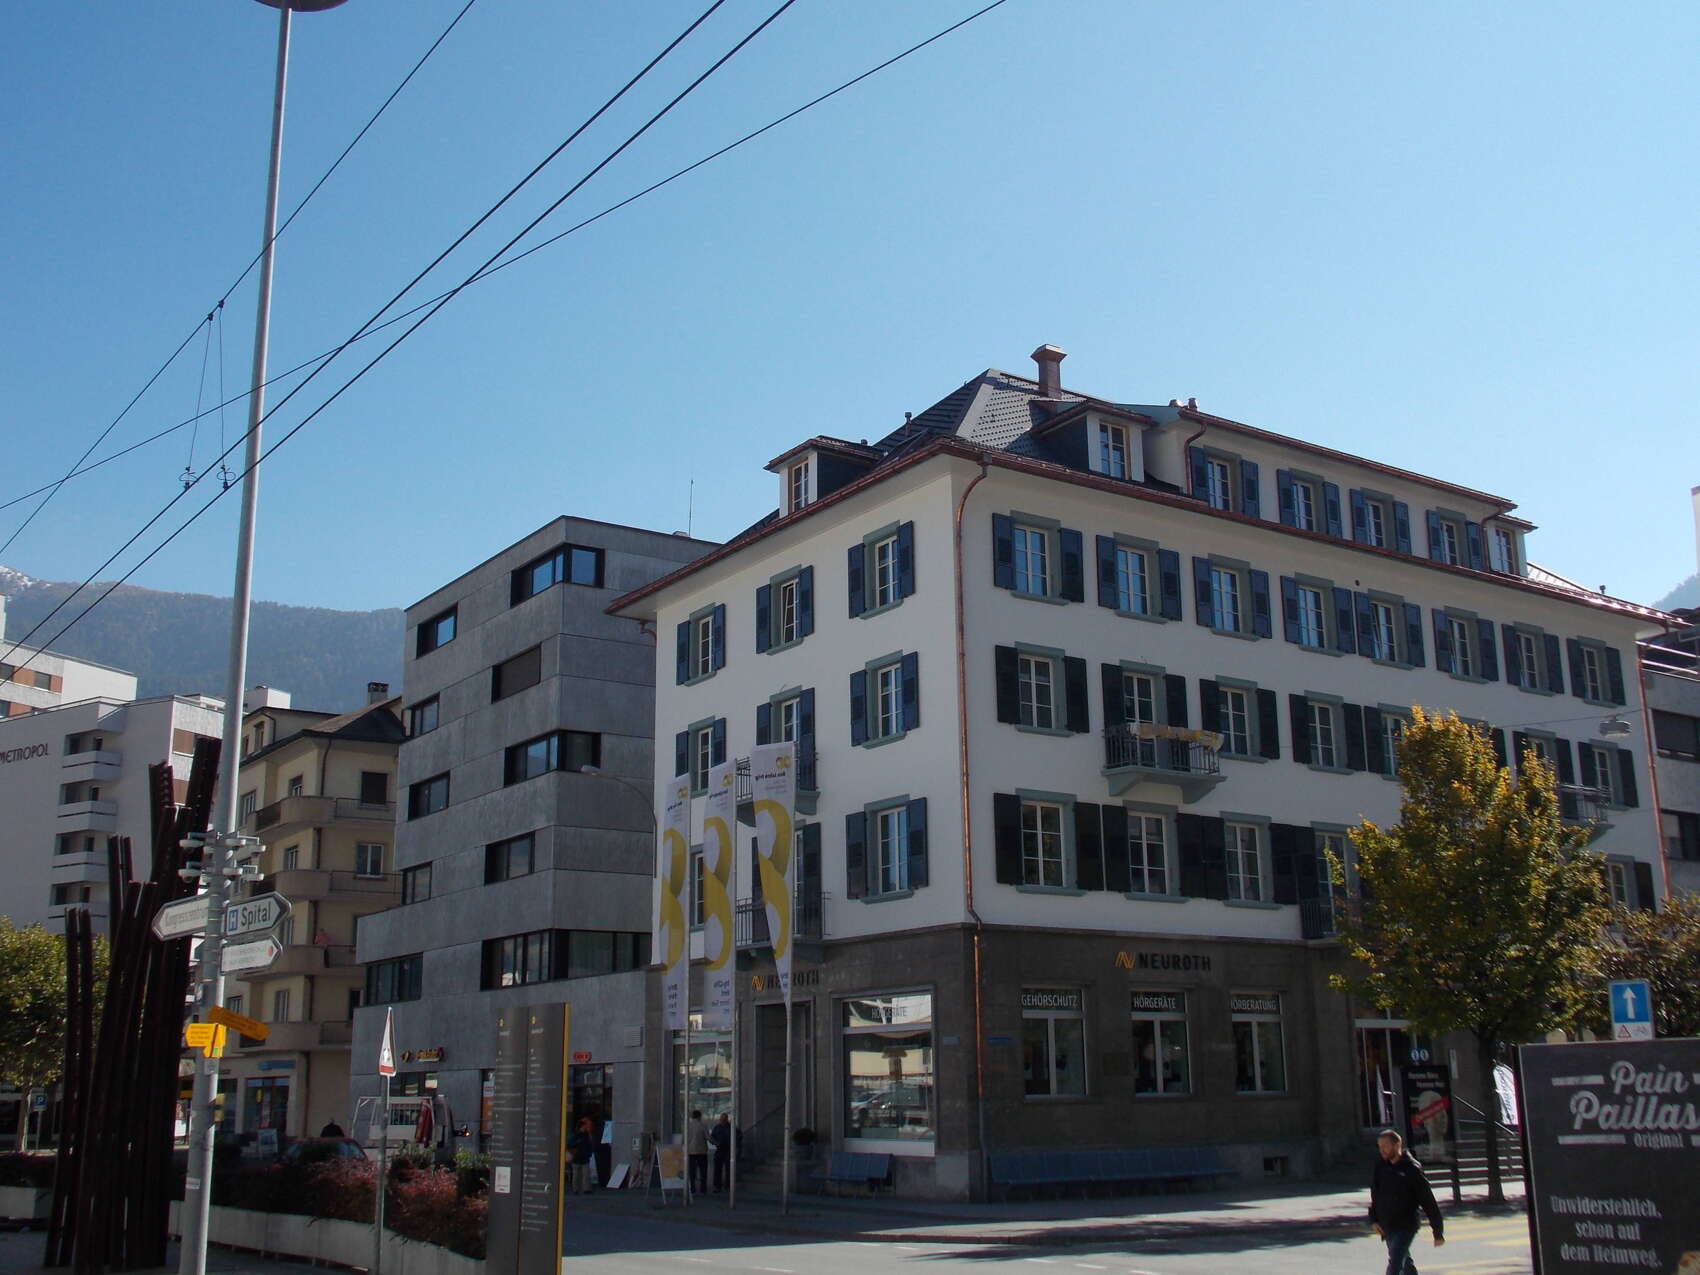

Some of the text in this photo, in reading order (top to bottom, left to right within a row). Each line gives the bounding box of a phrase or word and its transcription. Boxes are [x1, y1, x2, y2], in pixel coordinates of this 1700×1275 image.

[242, 901, 271, 929] Spital
[1139, 952, 1211, 970] NEUROTH
[1610, 1060, 1690, 1095] Pain
[1575, 1220, 1641, 1240] schon auf
[1560, 1242, 1663, 1268] dem Heimweg.
